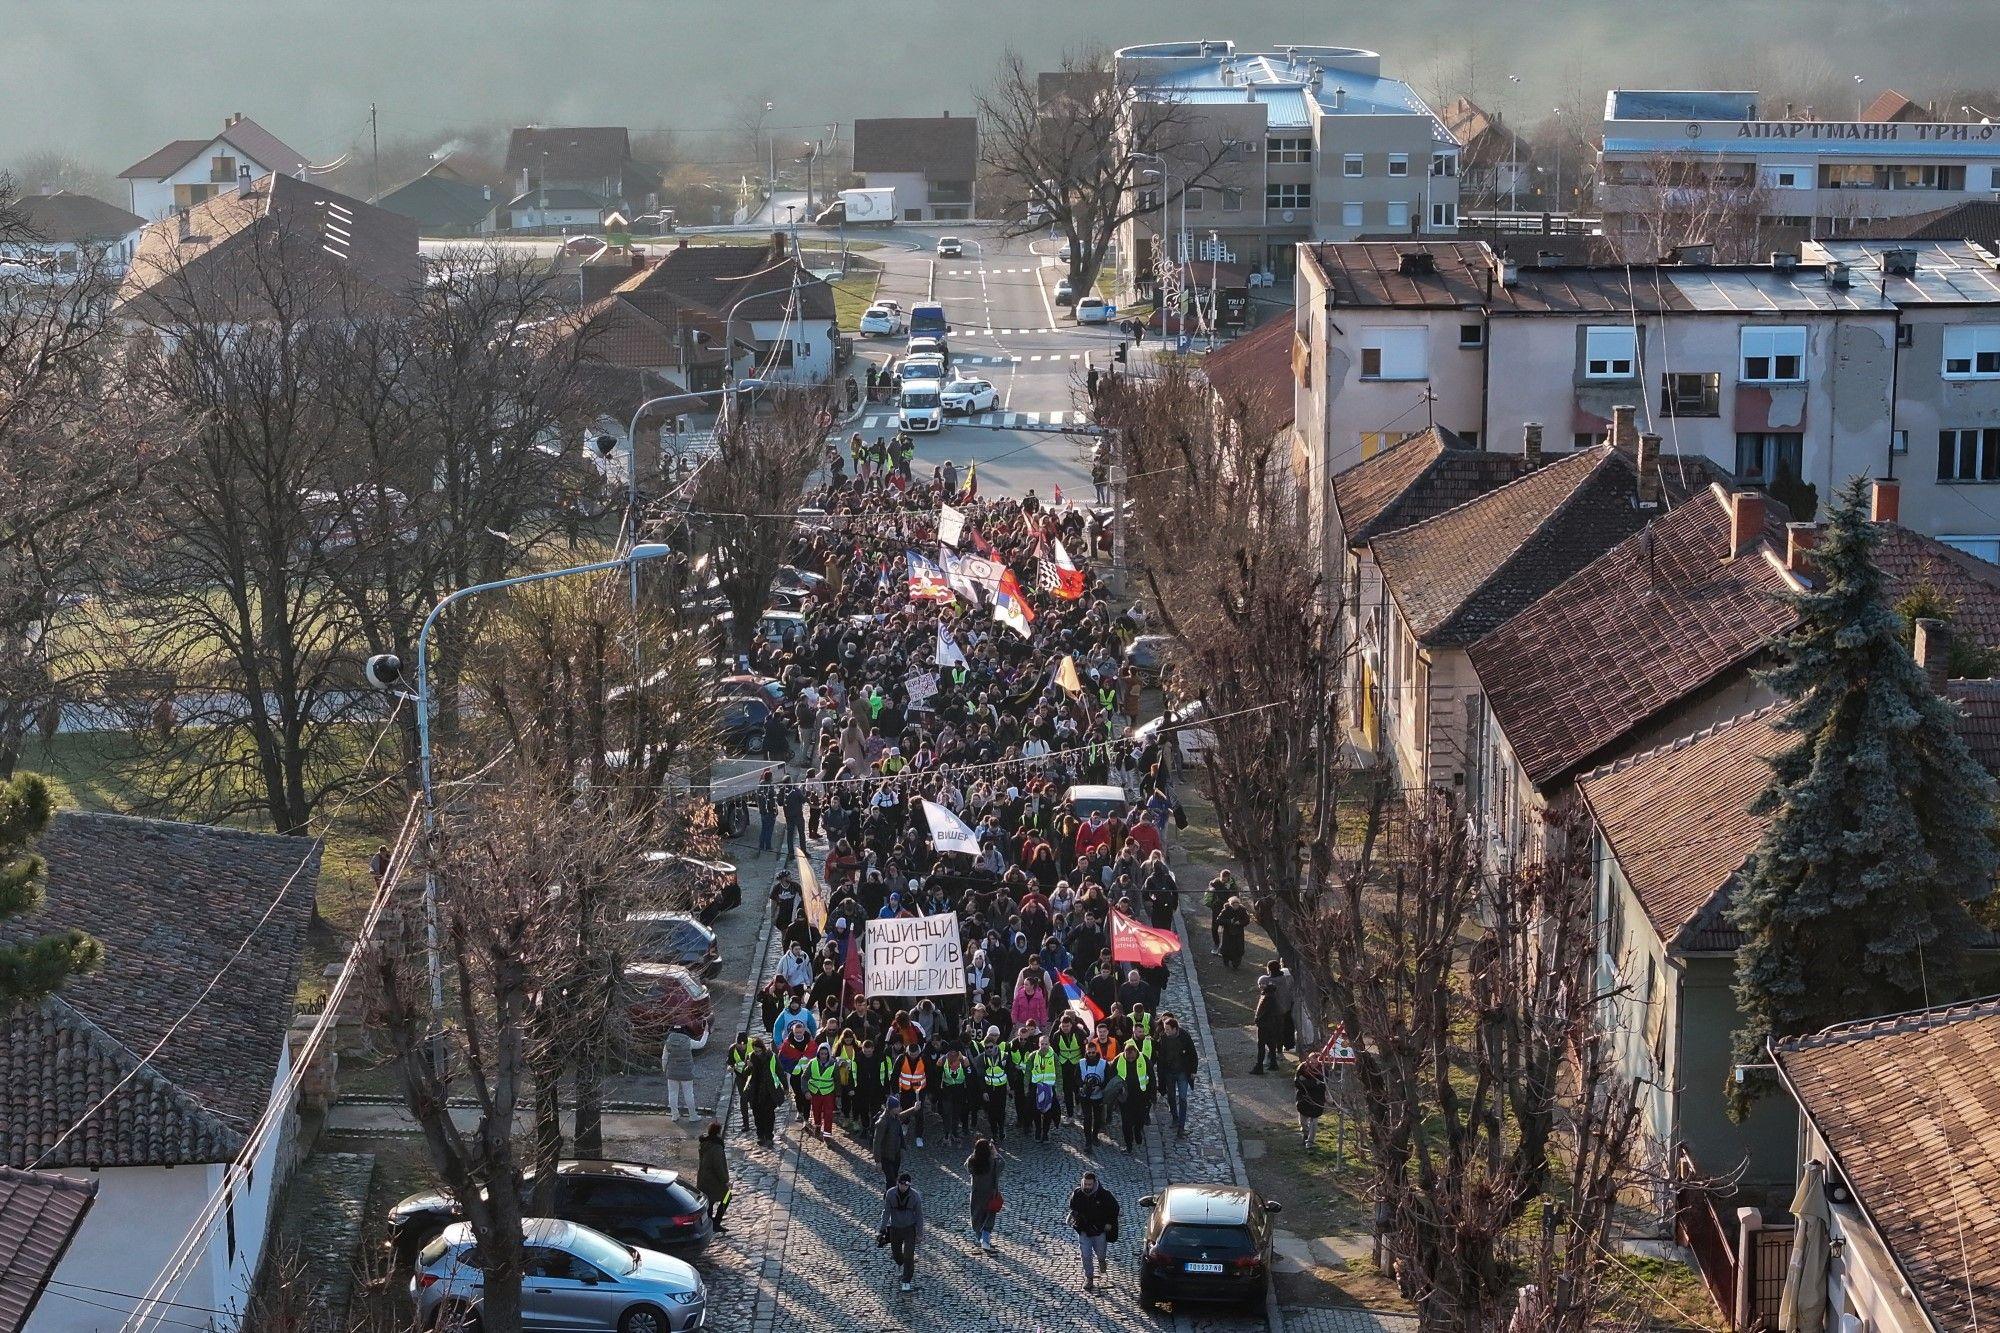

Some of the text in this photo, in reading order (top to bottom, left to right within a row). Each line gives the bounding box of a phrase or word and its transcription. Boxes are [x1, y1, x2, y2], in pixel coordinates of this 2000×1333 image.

[1738, 123, 1898, 139] АПАРТМАНИ
[1914, 124, 1968, 140] ТРИ
[868, 920, 954, 944] МАШИНЦИ
[874, 943, 959, 965] ПРОТИВ
[867, 967, 964, 992] МАШИНЕРИЈЕ
